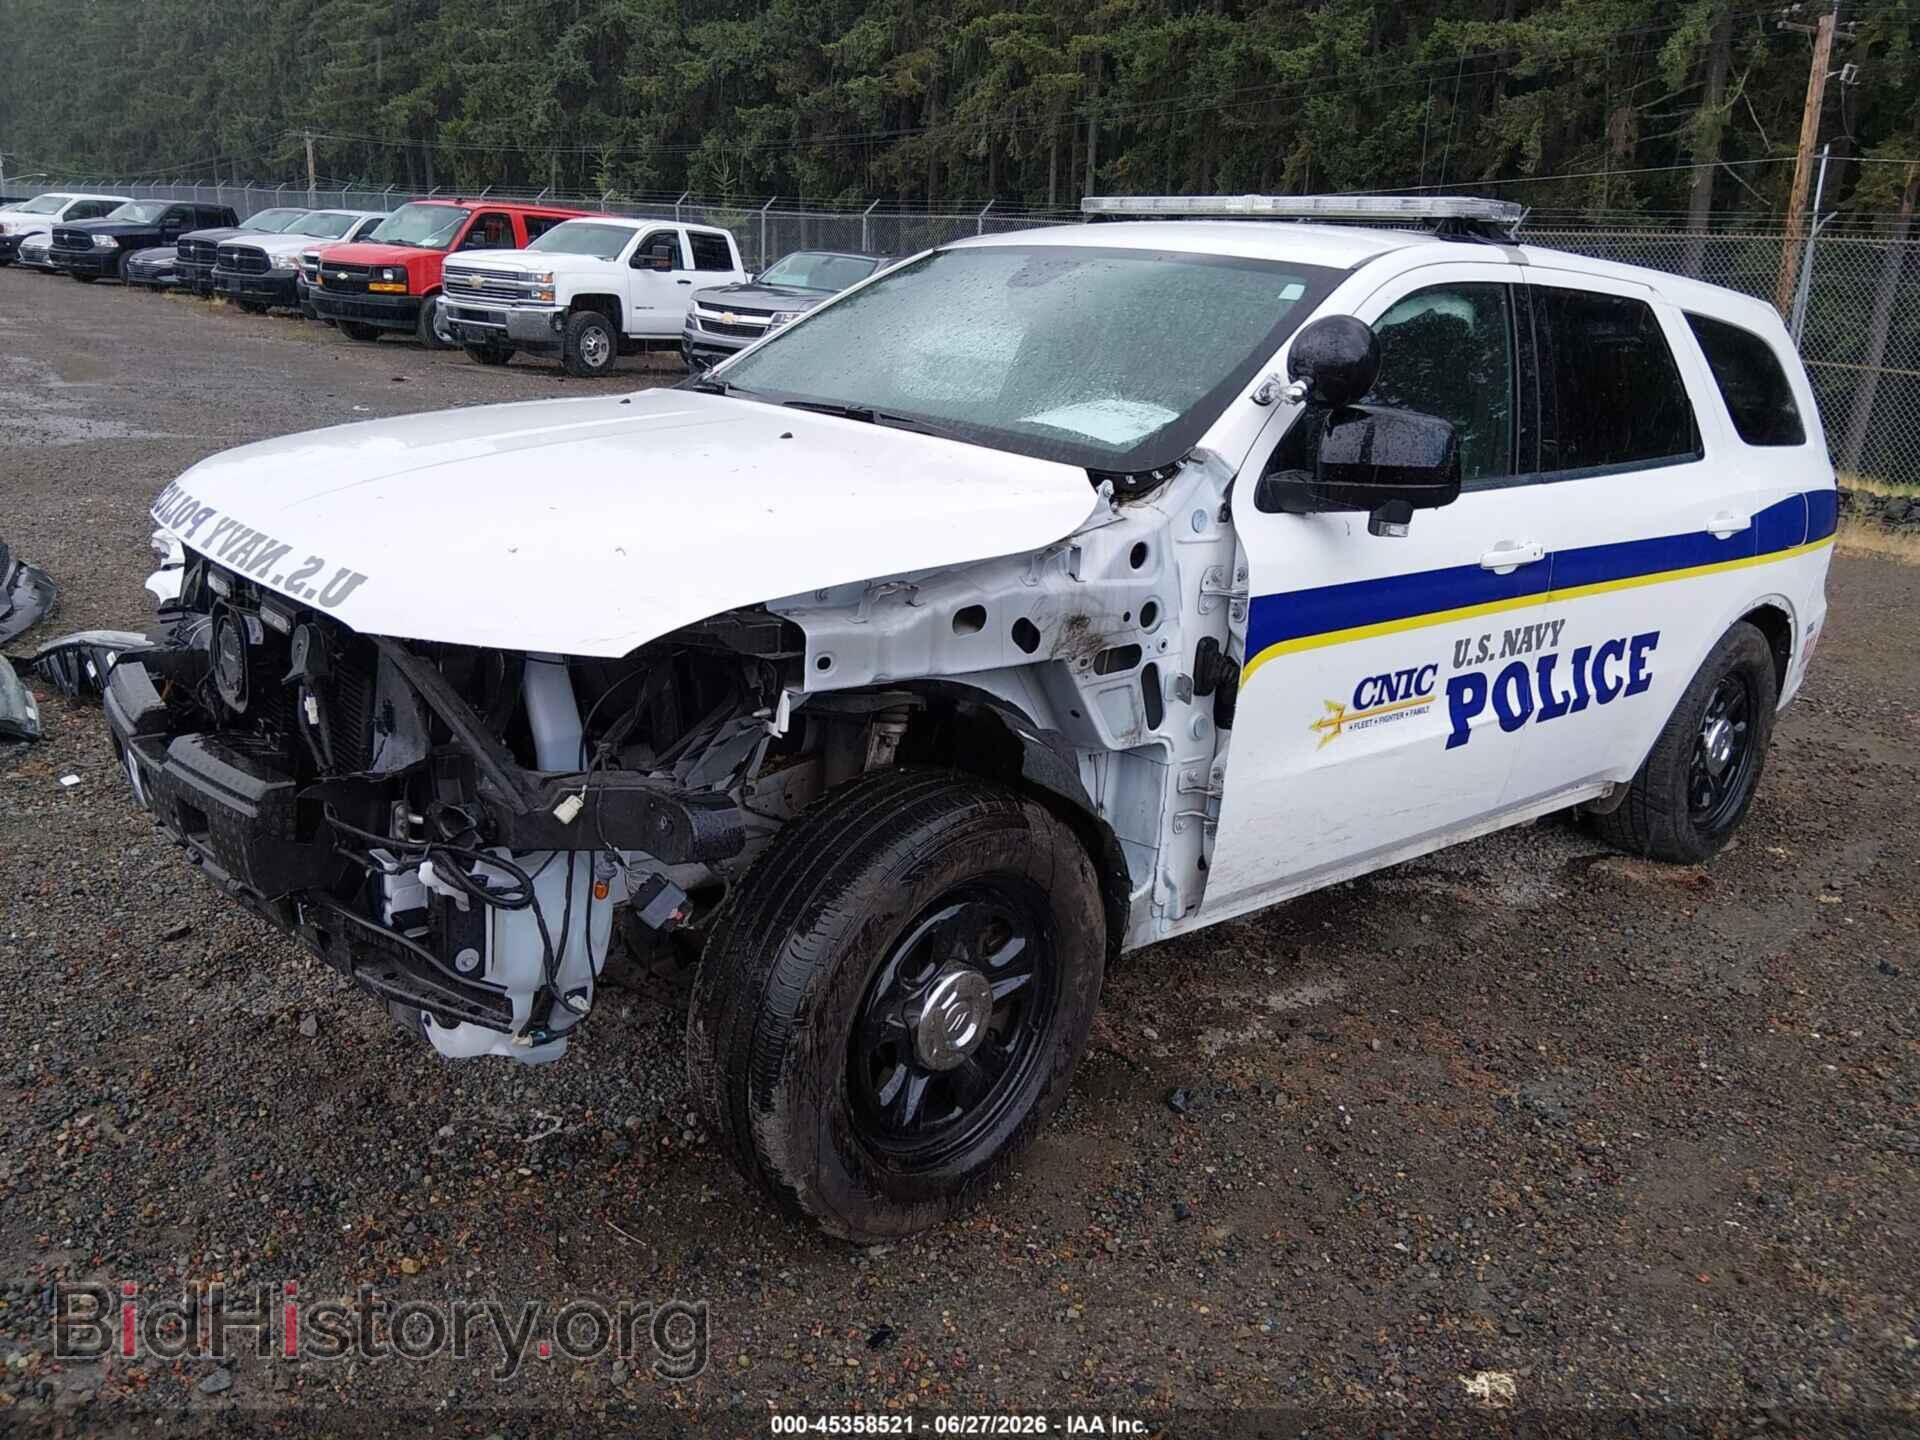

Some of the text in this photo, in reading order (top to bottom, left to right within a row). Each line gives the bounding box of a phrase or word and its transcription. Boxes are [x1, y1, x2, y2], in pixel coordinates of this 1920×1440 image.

[1453, 618, 1566, 669] U.S. NAVY
[1352, 663, 1439, 711] CNIC
[1445, 630, 1661, 750] POLICE
[1353, 705, 1431, 730] FLEET FIGHTER FAMILY
